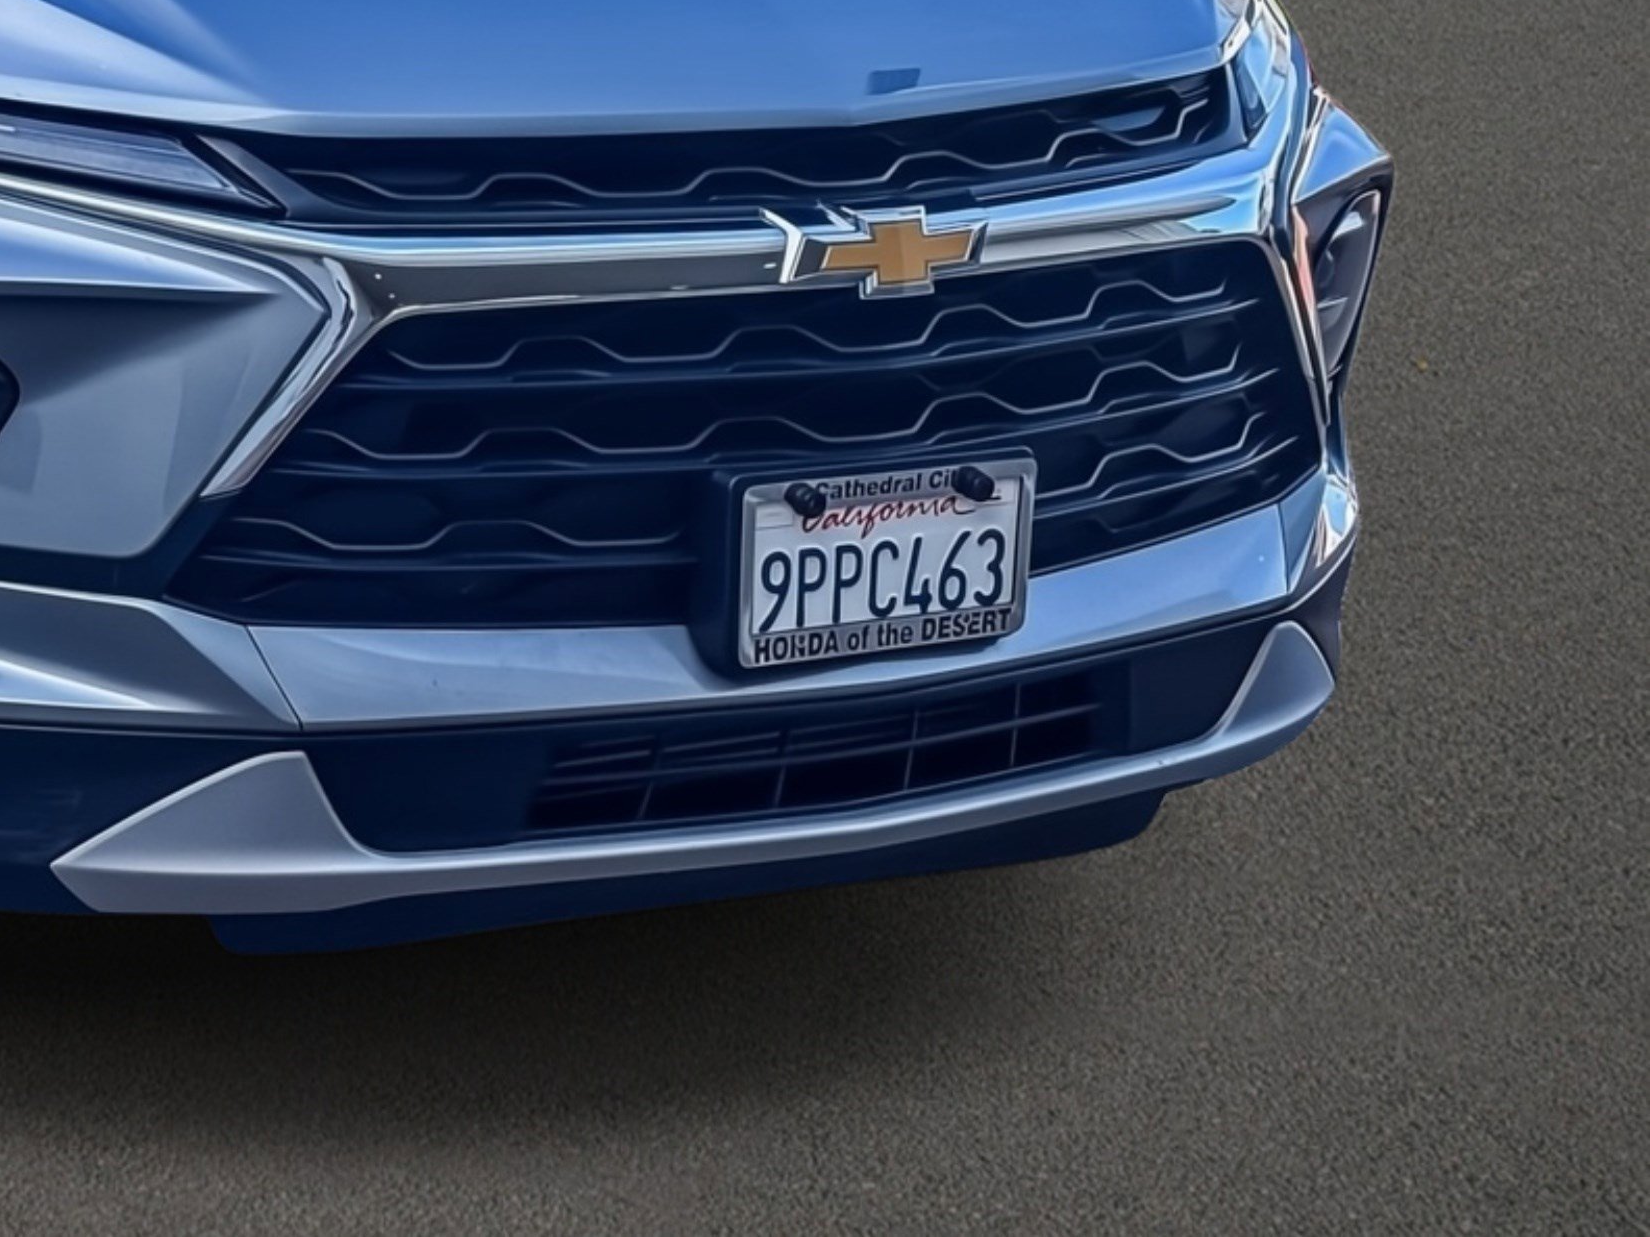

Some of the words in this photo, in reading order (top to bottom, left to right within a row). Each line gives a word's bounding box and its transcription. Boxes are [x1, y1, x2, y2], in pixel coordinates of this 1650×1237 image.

[760, 528, 1006, 633] 9PPC463
[754, 631, 839, 664] HONDA
[846, 623, 870, 651] of
[876, 621, 913, 647] the
[921, 608, 1013, 641] DESERT
